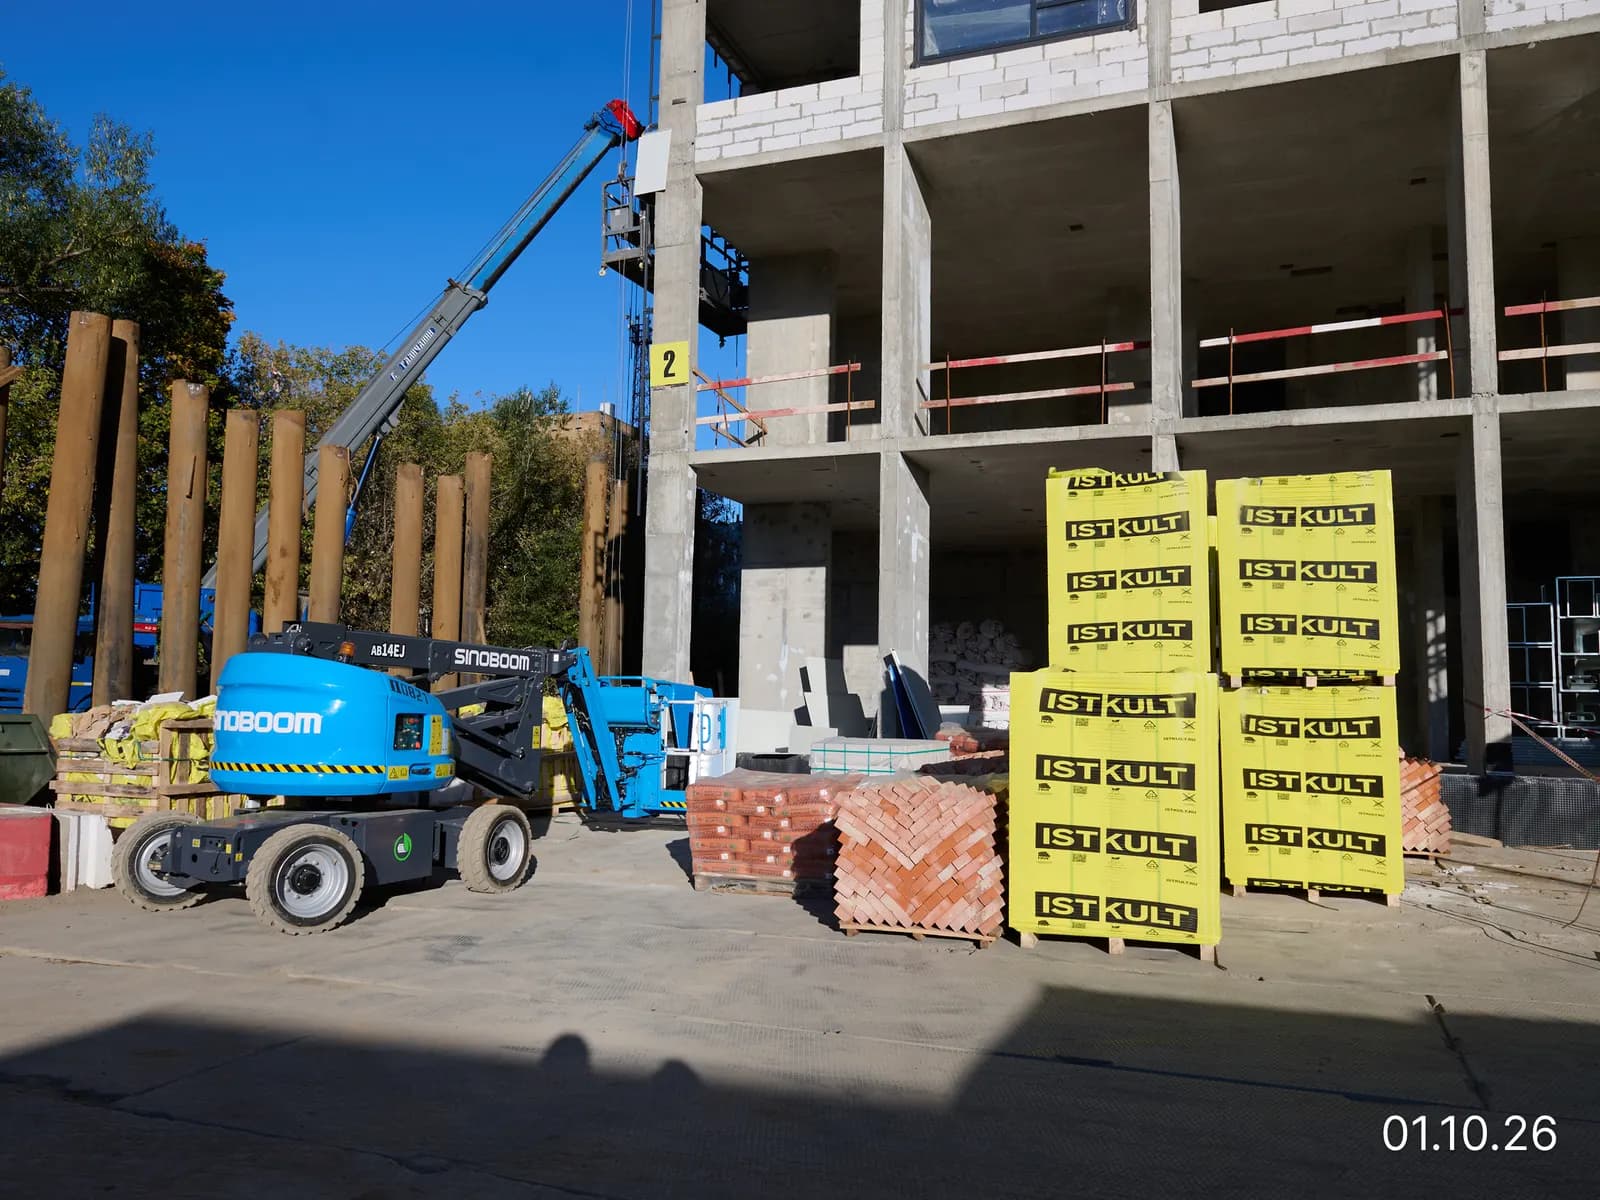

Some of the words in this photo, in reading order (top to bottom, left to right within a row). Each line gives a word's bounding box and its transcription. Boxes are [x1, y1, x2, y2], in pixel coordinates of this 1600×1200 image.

[663, 349, 676, 378] 2
[370, 643, 405, 658] AB14EJ
[454, 648, 530, 671] SINOBOOM
[214, 710, 322, 734] NOBOOM
